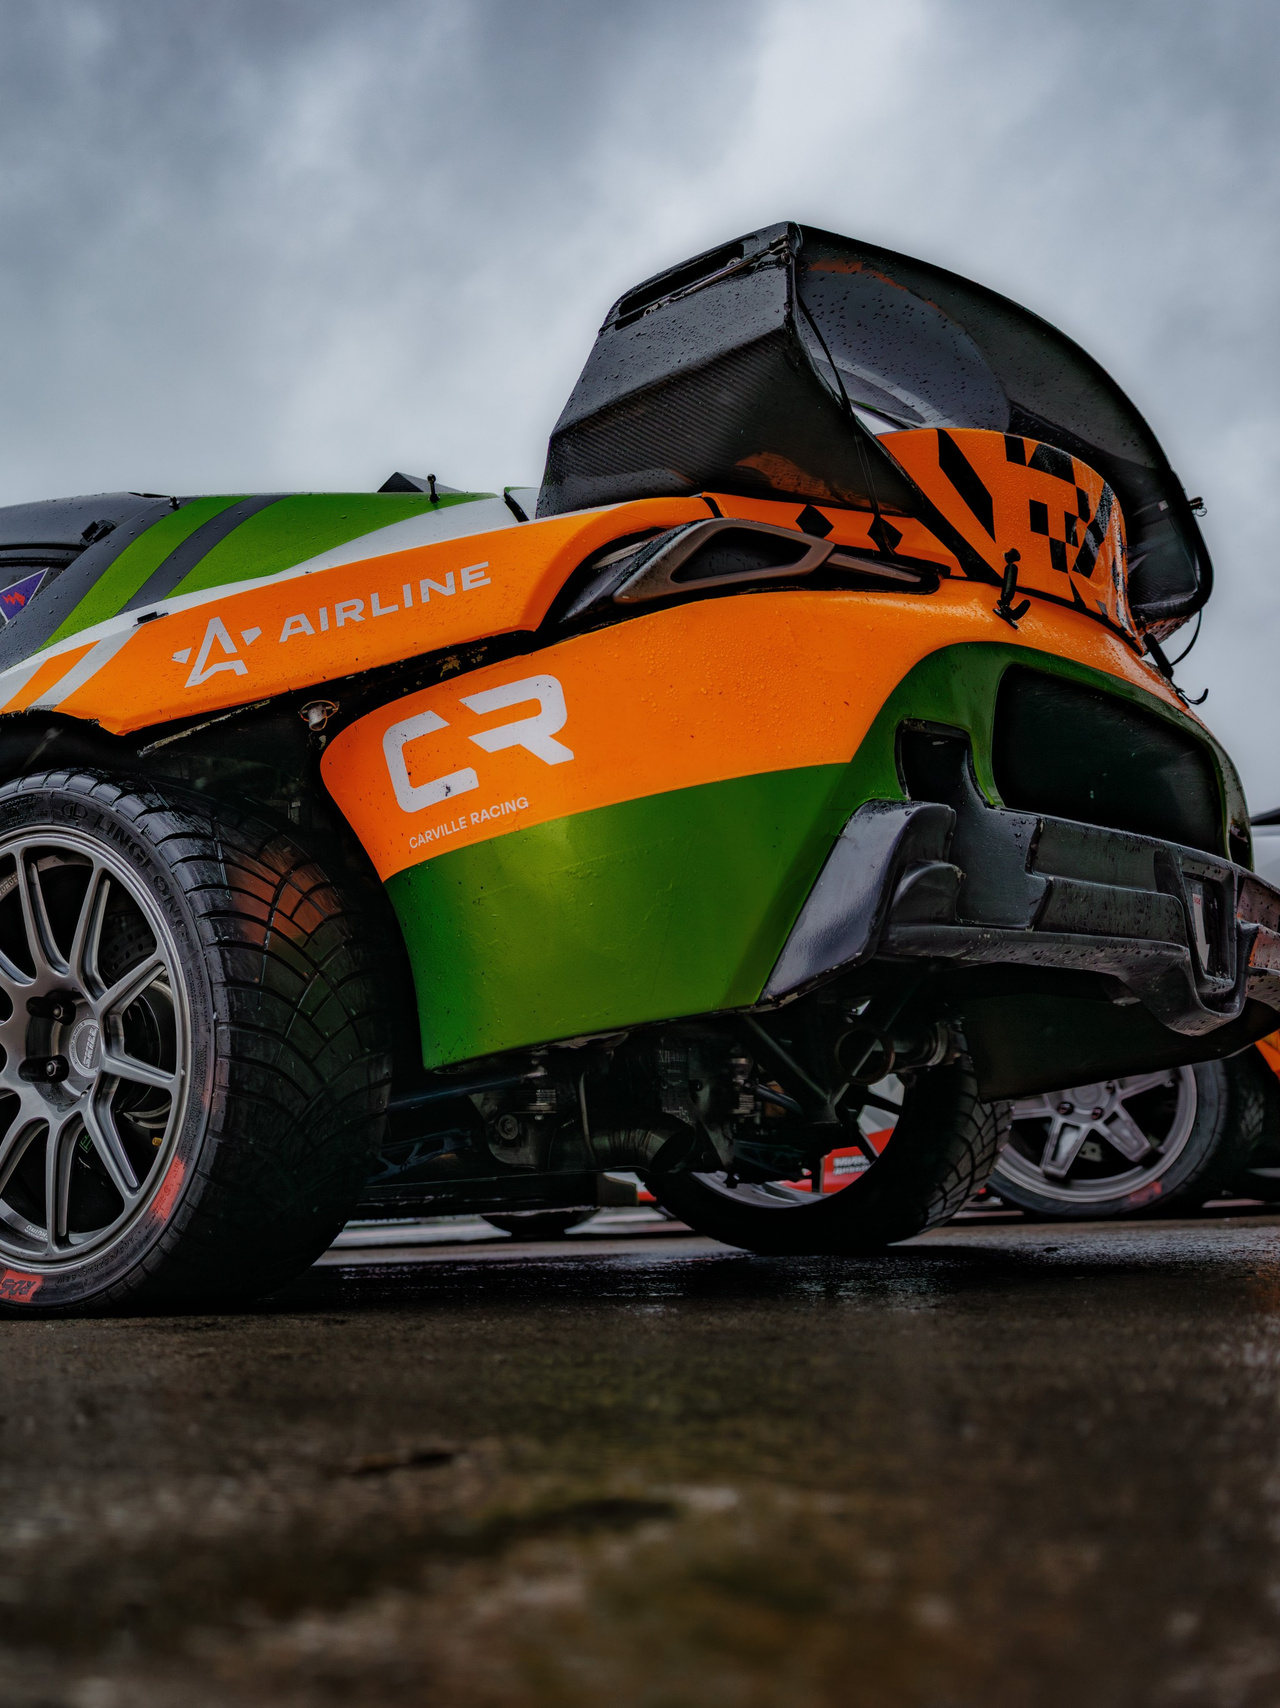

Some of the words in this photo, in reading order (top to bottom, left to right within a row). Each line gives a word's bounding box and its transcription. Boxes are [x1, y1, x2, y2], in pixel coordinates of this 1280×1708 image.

[278, 561, 492, 643] AIRLINE
[382, 674, 575, 813] CR
[409, 816, 468, 849] CARVILLE
[470, 796, 529, 825] RACING
